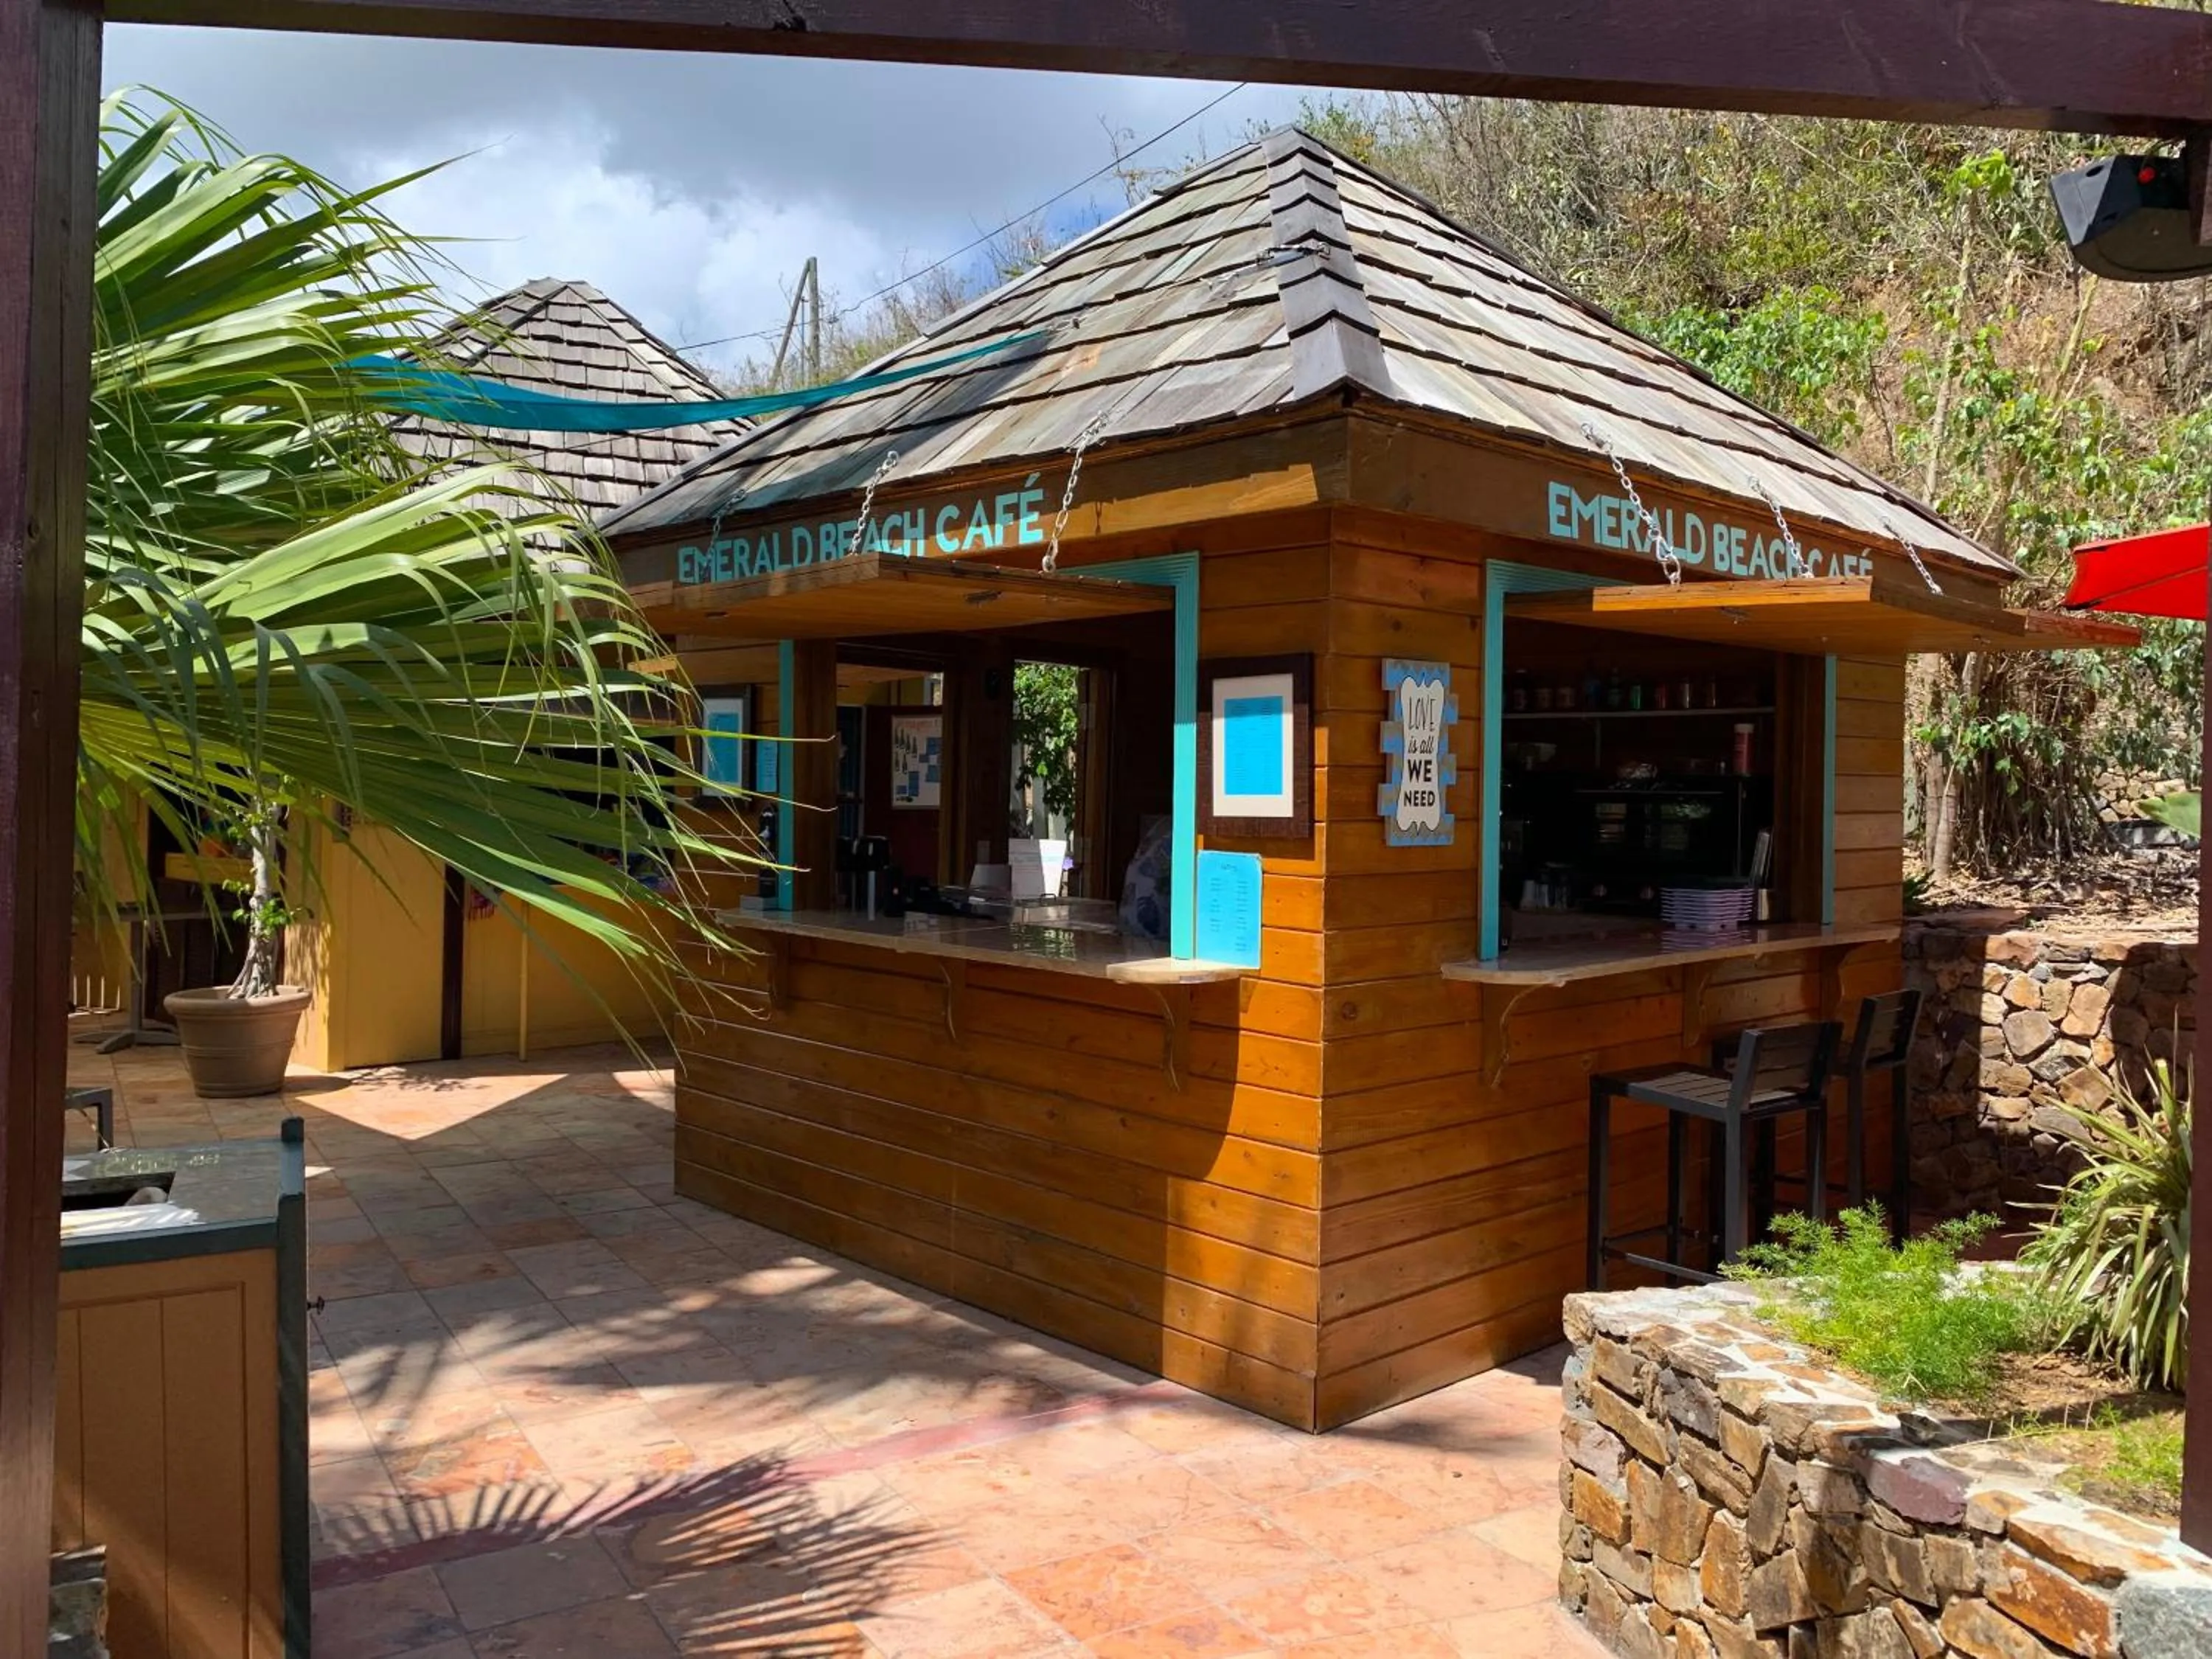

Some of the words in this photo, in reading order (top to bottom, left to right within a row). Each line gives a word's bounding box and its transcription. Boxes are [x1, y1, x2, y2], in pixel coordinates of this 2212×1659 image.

[678, 526, 813, 583] EMERALD
[819, 508, 925, 563] BEACH
[936, 472, 1044, 553] CAFÉ
[1548, 481, 1707, 564] EMERALD
[1712, 522, 1802, 579] BEACH
[1408, 695, 1437, 732] LOVE
[1408, 735, 1418, 754] is
[1419, 734, 1434, 754] all
[1407, 759, 1433, 782] WE
[1403, 790, 1436, 807] NEED
